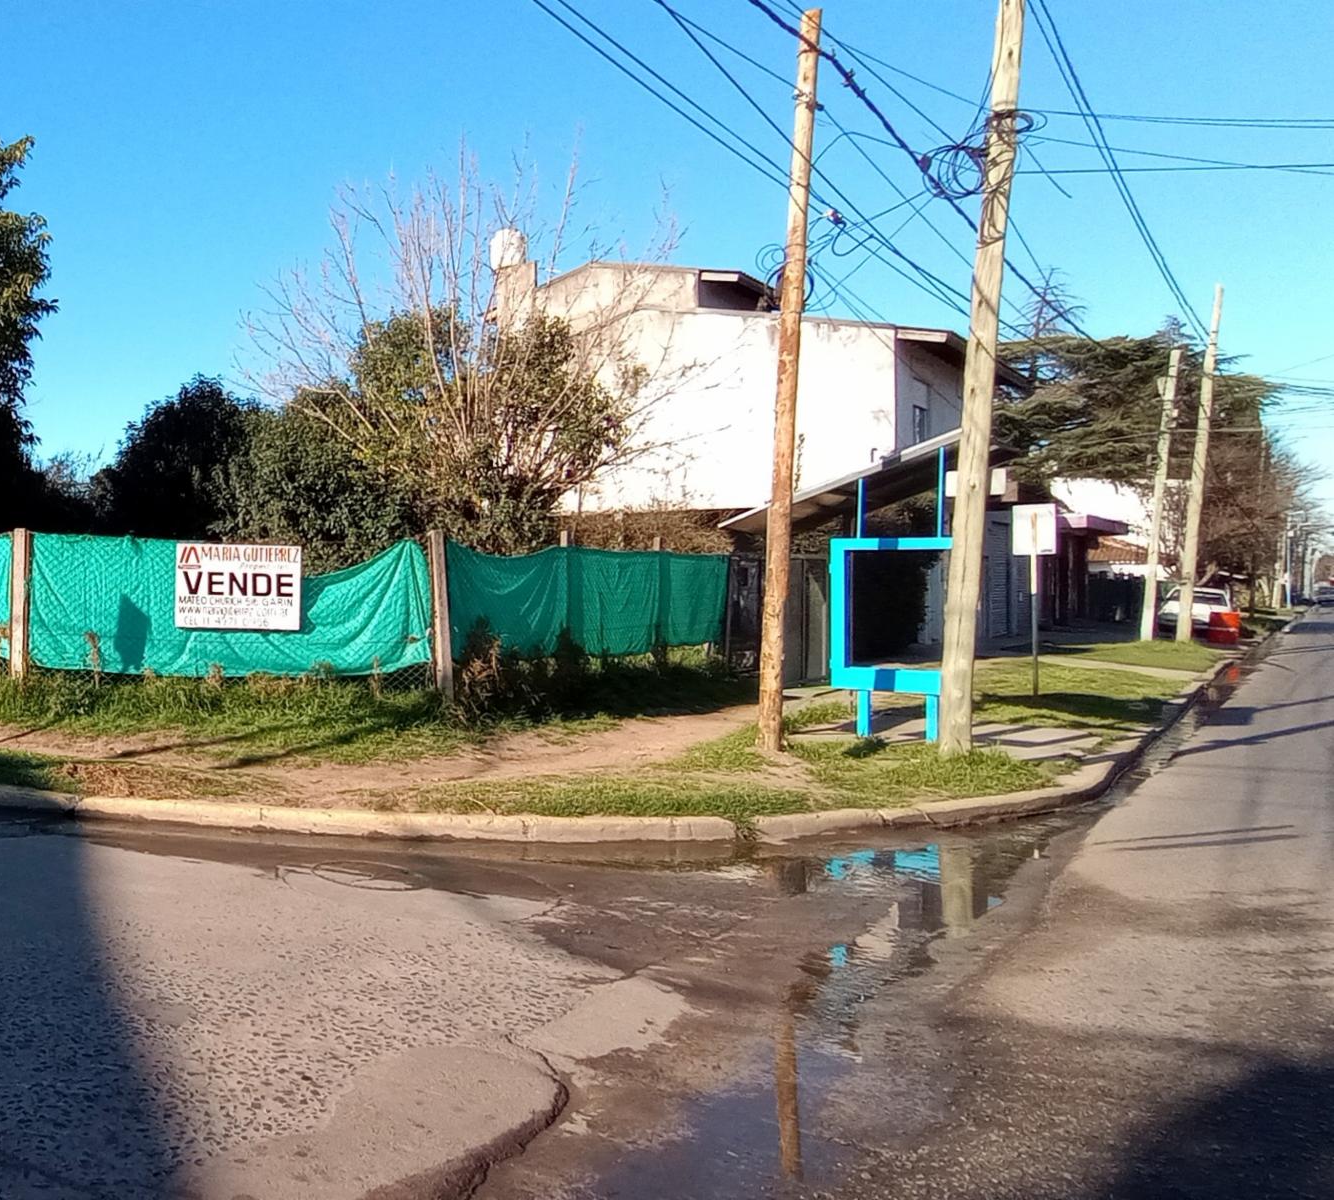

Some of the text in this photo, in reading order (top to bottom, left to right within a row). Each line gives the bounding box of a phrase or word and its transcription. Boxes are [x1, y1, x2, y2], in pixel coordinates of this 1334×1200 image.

[200, 546, 240, 561] MARIA
[182, 571, 294, 597] VENDE
[179, 595, 207, 606] MATEO
